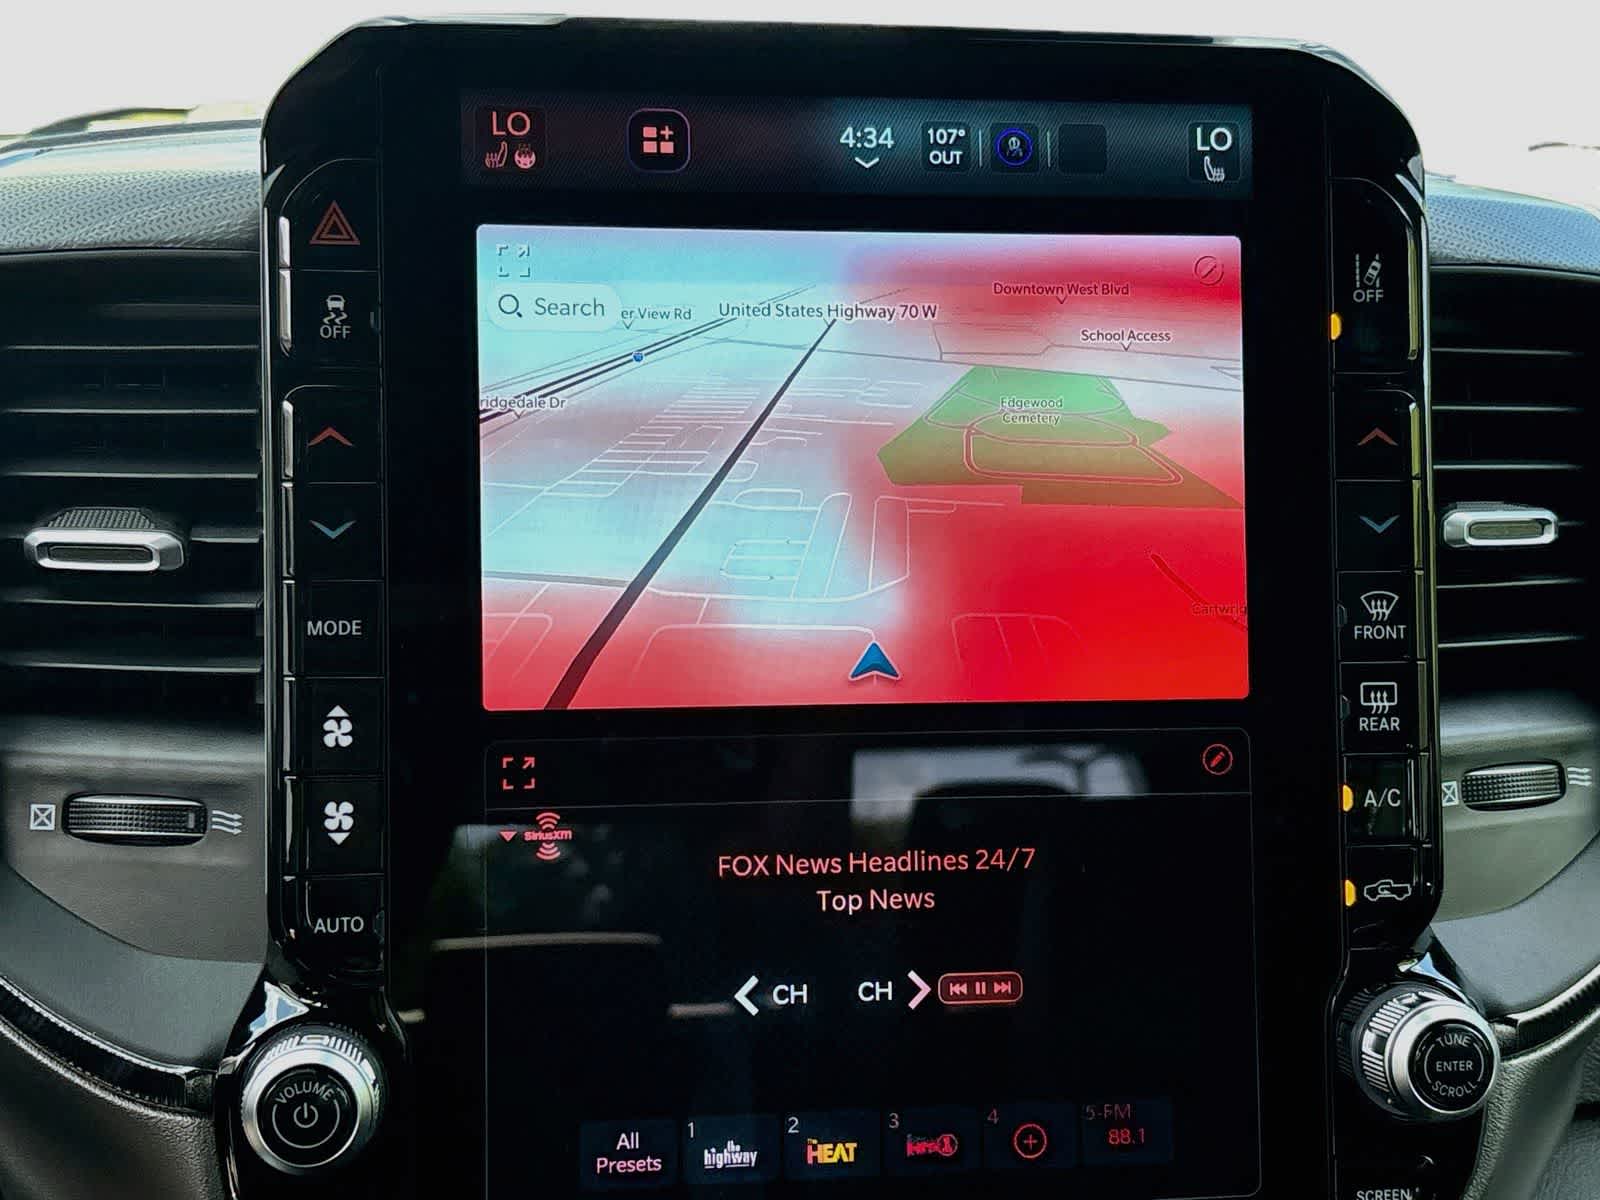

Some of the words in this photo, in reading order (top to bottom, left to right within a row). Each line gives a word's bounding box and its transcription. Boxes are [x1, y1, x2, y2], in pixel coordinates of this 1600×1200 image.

[492, 111, 531, 136] LO
[839, 126, 895, 149] 4:34
[1196, 127, 1233, 152] LO
[929, 151, 963, 166] OUT
[993, 282, 1063, 296] Downtown
[1067, 283, 1098, 296] West
[1101, 283, 1130, 296] Blvd
[1353, 289, 1384, 303] OFF
[534, 297, 605, 318] Search
[621, 310, 635, 320] er
[638, 307, 671, 320] View
[674, 308, 692, 321] Rd
[719, 302, 771, 319] United
[774, 302, 823, 319] States
[827, 303, 896, 324] Highway
[900, 304, 919, 320] 70
[922, 305, 938, 319] W
[320, 325, 351, 339] OFF
[1080, 329, 1125, 342] School
[1127, 329, 1171, 343] Access
[480, 396, 546, 410] ridgedale
[549, 397, 566, 409] Dr
[1000, 396, 1063, 411] Edgewood
[1002, 412, 1060, 426] Cemetery
[307, 620, 362, 636] MODE
[1354, 625, 1407, 640] FRONT
[1359, 716, 1401, 732] REAR
[1364, 788, 1401, 807] A/C
[718, 854, 770, 878] FOX
[776, 853, 842, 876] News
[849, 849, 969, 874] Headlines
[975, 847, 1036, 872] 24/7
[816, 890, 863, 915] Top
[870, 888, 936, 910] News
[313, 916, 365, 934] AUTO
[772, 983, 808, 1006] CH
[857, 981, 893, 1002] CH
[1436, 1033, 1472, 1048] TUNE
[1435, 1060, 1473, 1072] ENTER
[275, 1080, 334, 1105] VOLUME
[1431, 1080, 1477, 1097] SCROLL
[788, 1116, 800, 1134] 2
[889, 1112, 900, 1129] 3
[987, 1108, 999, 1125] 4
[687, 1122, 695, 1138] 1
[1108, 1128, 1145, 1145] 88.1
[616, 1132, 640, 1151] All
[704, 1148, 758, 1168] highway
[807, 1142, 858, 1165] HEAT
[596, 1155, 662, 1174] Presets
[1356, 1188, 1410, 1200] SCREEN
